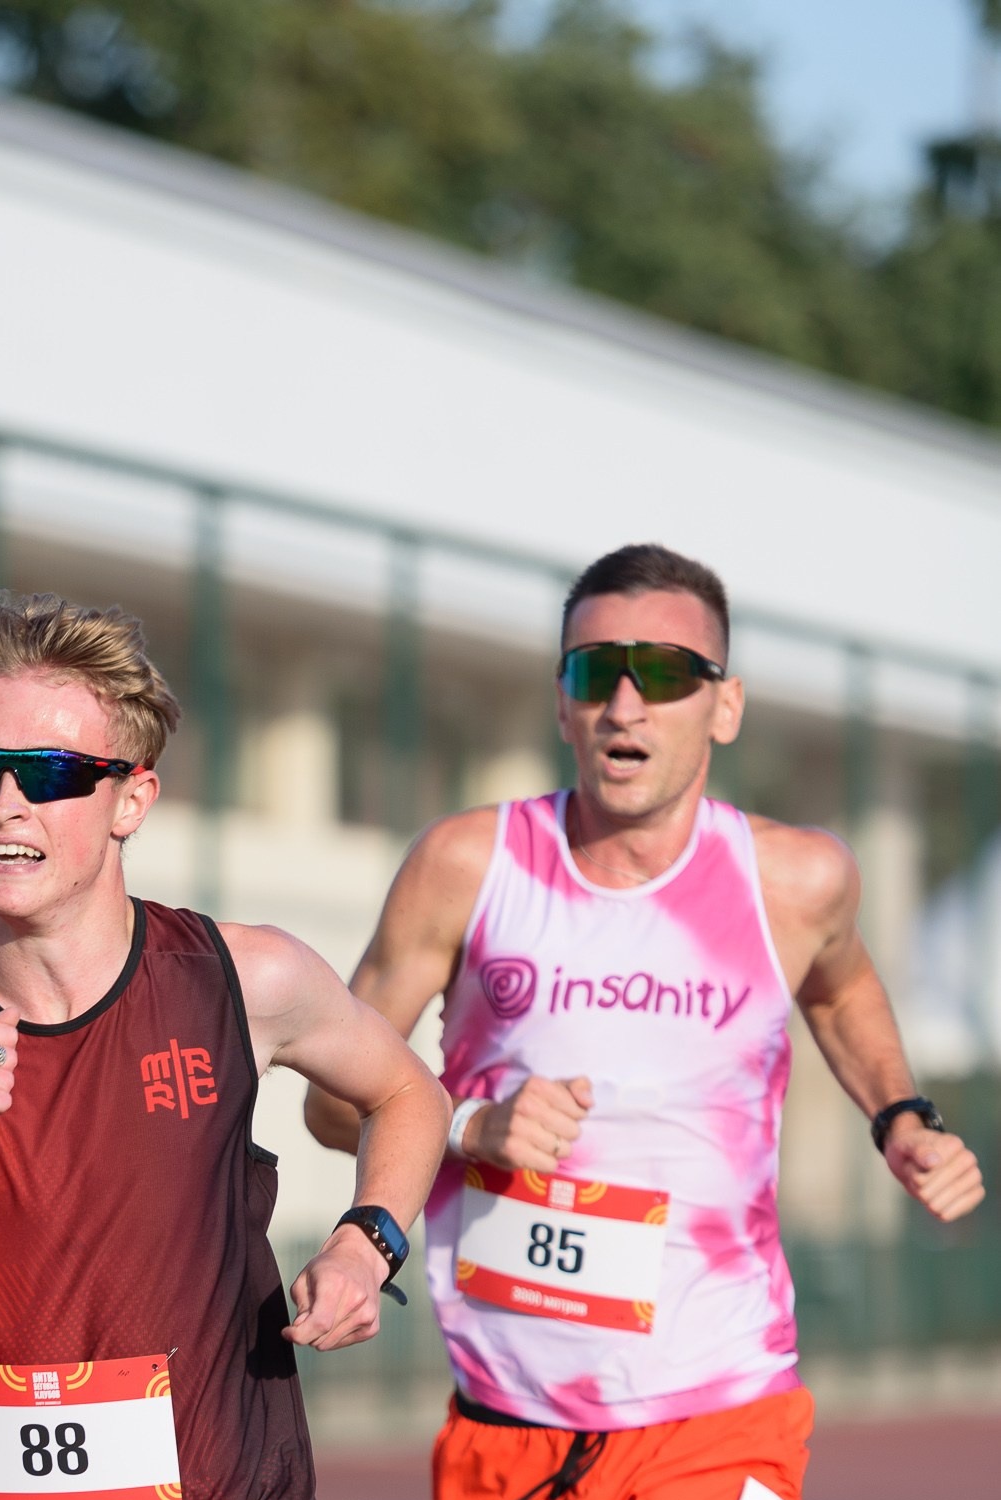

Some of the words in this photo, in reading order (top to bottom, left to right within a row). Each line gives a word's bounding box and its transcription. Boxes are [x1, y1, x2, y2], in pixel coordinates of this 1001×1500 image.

[550, 966, 751, 1029] insanity
[527, 1223, 586, 1274] 85
[32, 1371, 58, 1383] БИТВА
[20, 1422, 89, 1476] 88
